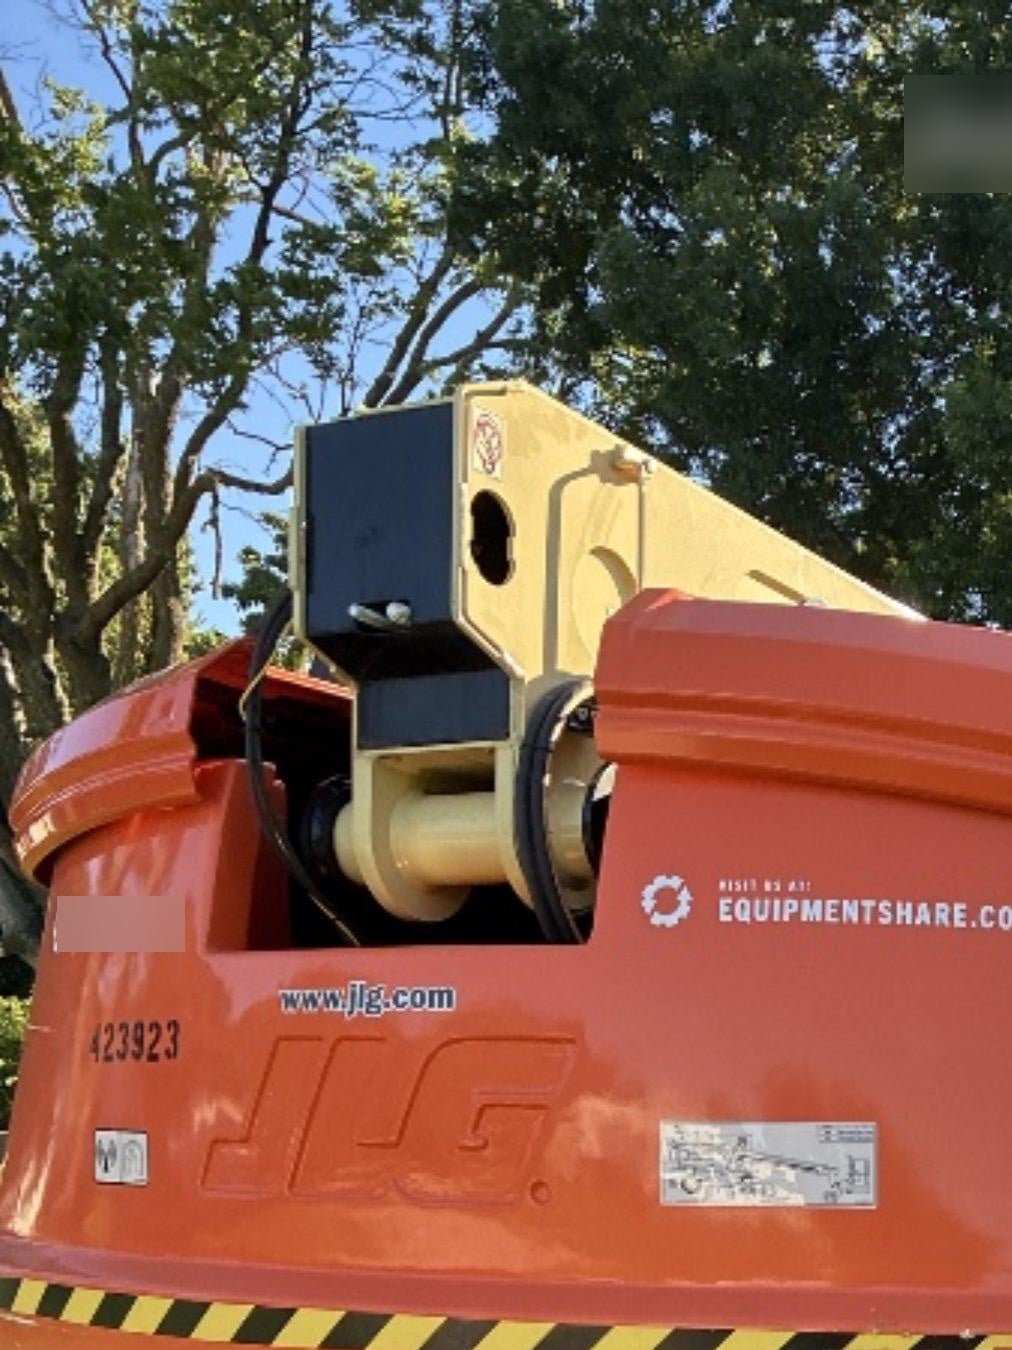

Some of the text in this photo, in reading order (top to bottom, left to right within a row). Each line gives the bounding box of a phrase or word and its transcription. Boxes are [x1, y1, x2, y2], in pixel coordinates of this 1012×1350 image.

[279, 982, 455, 1017] www.jlg.com
[90, 1019, 180, 1063] 423923
[201, 1036, 577, 1208] JLG
